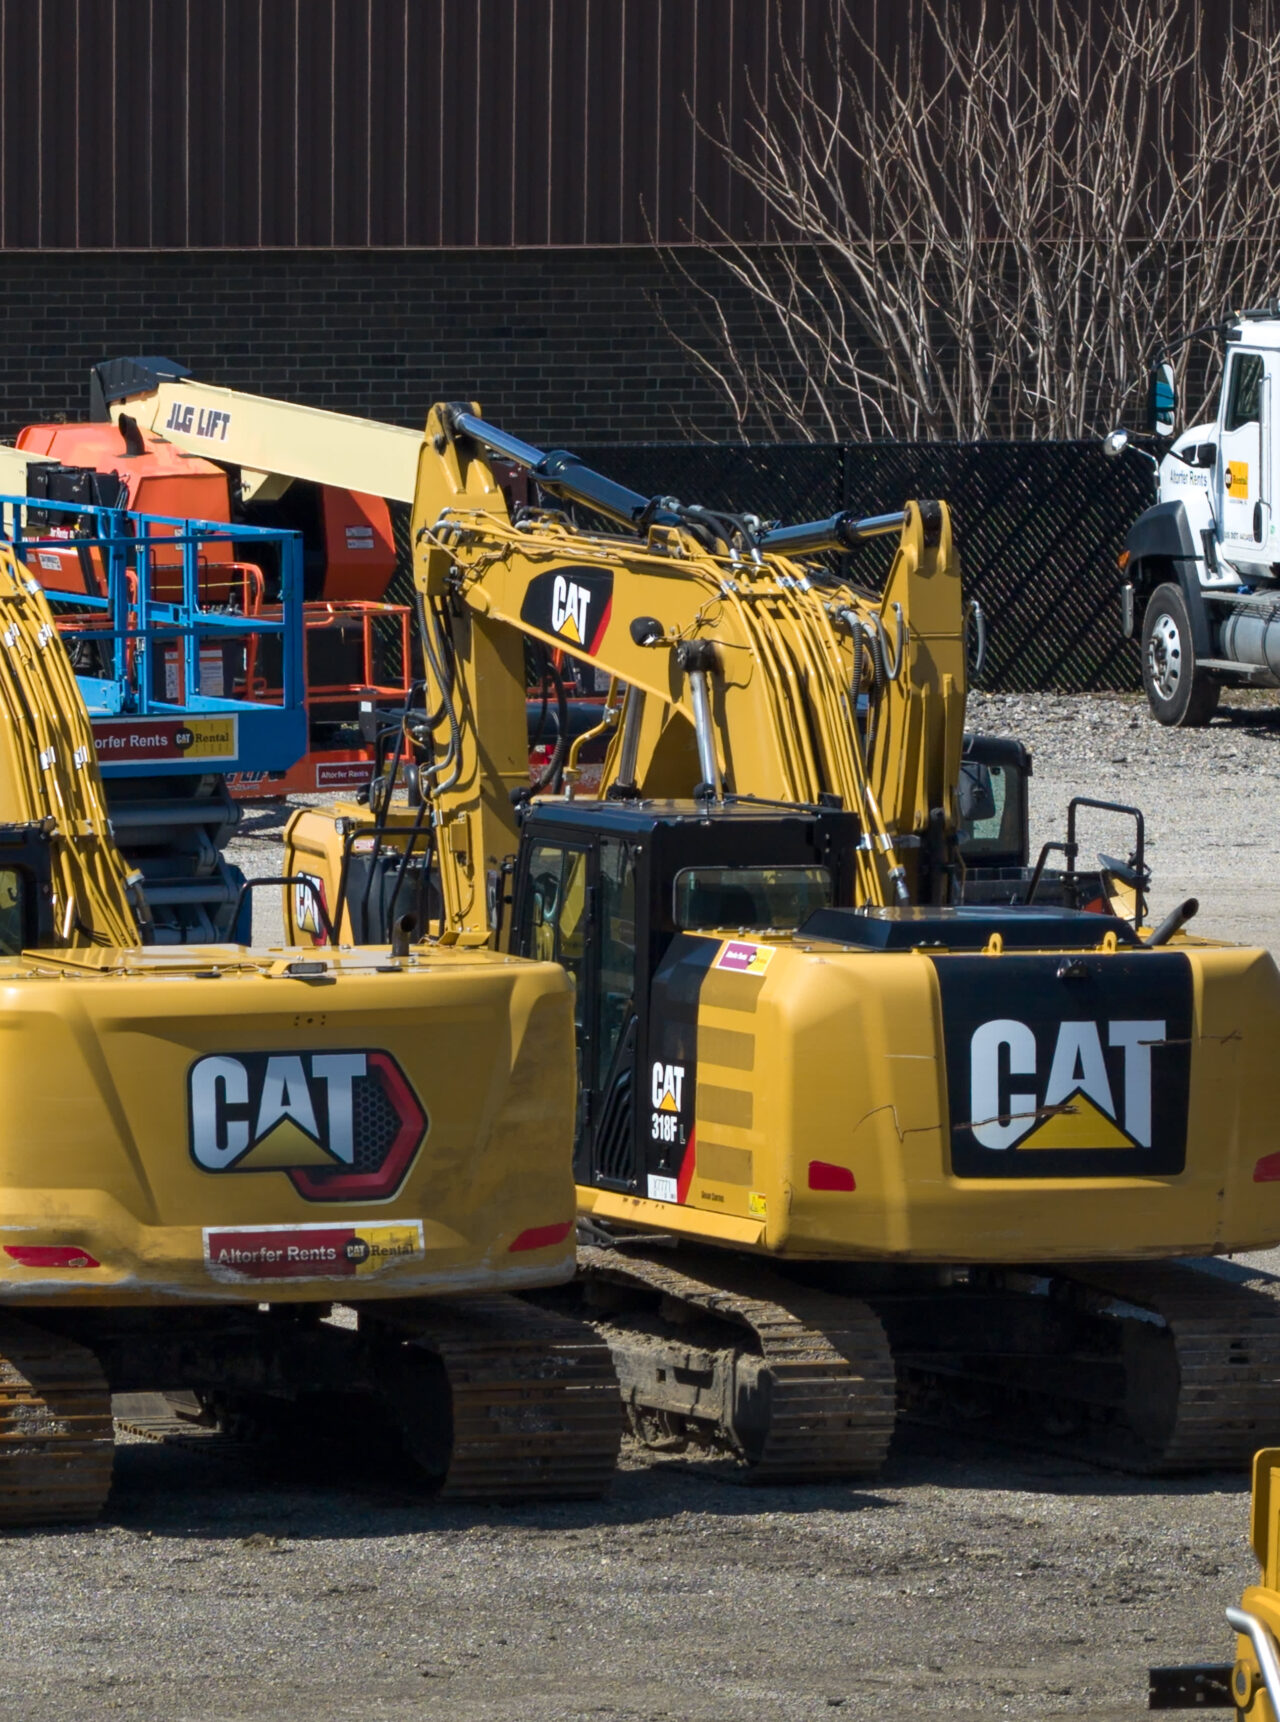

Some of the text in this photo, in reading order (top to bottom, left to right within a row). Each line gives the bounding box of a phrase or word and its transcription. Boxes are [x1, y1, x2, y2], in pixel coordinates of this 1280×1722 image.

[166, 402, 231, 441] JLG LIFT
[1170, 469, 1208, 488] Altorfer Rents
[552, 574, 591, 645] CAT
[93, 732, 229, 749] orfer Rents CAT Rental
[321, 769, 369, 780] Altorfer Rents
[296, 872, 321, 934] CAT
[651, 1061, 685, 1113] CAT
[970, 1018, 1167, 1150] CAT
[191, 1053, 367, 1169] CAT
[651, 1112, 678, 1142] 318F
[217, 1242, 415, 1264] Altorfer Rents CAT Rental
